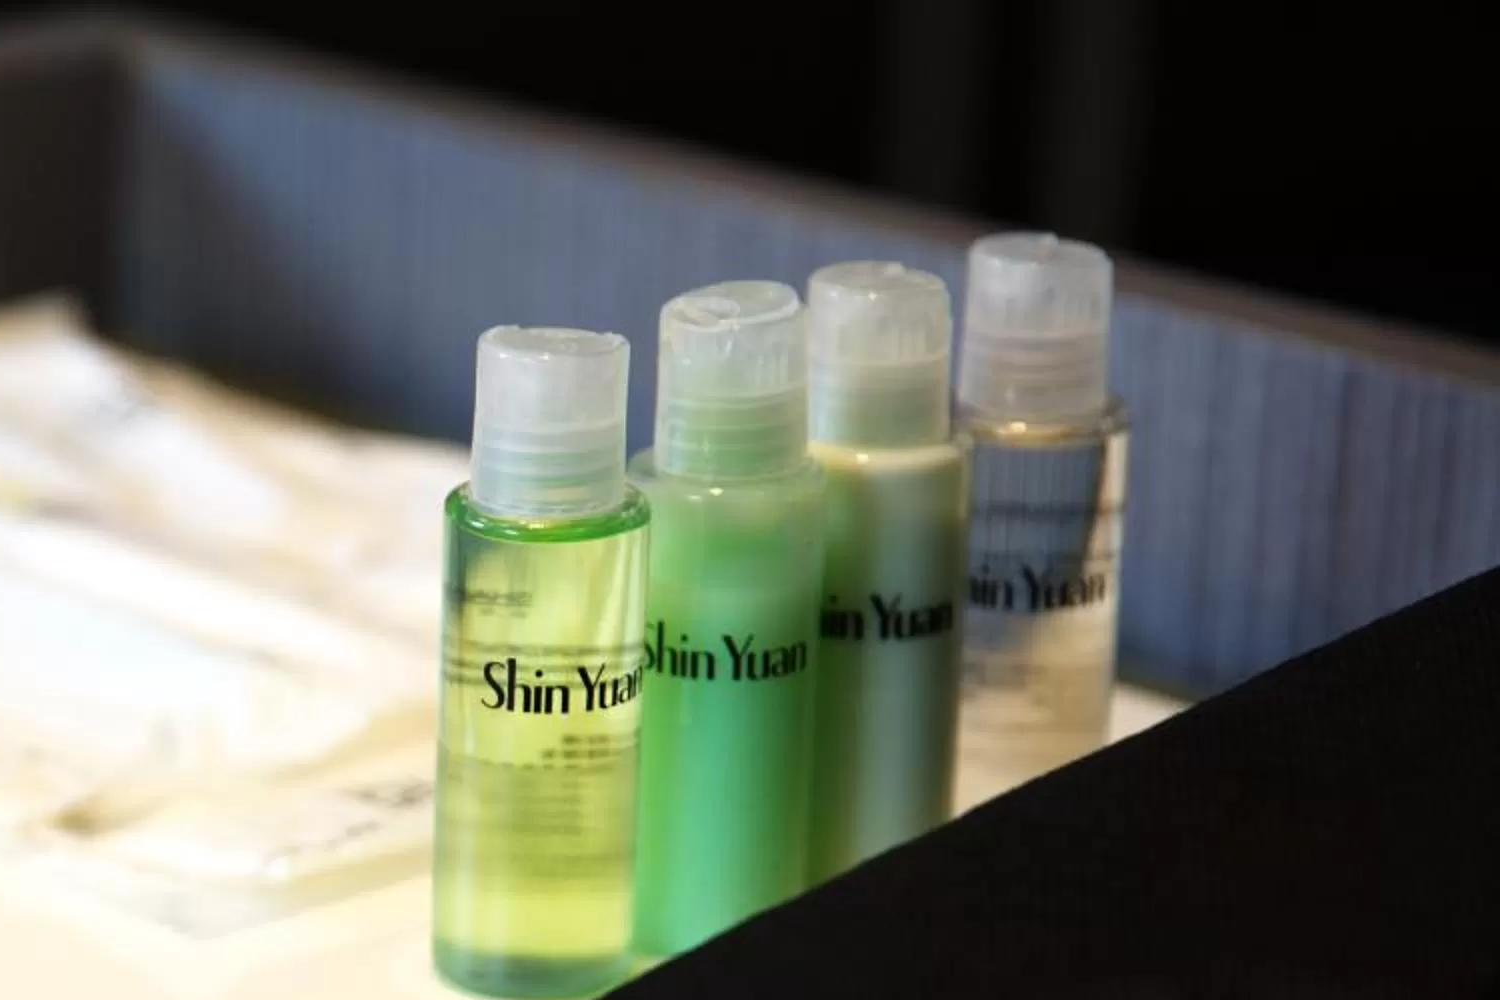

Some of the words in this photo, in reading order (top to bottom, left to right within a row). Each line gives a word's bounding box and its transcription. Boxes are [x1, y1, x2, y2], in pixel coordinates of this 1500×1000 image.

[969, 563, 1014, 611] in
[1021, 562, 1106, 613] Yuan
[820, 595, 864, 640] in
[870, 590, 953, 641] Yuan
[721, 632, 807, 681] Yuan
[481, 657, 570, 715] Shin
[577, 663, 644, 712] Yuan
